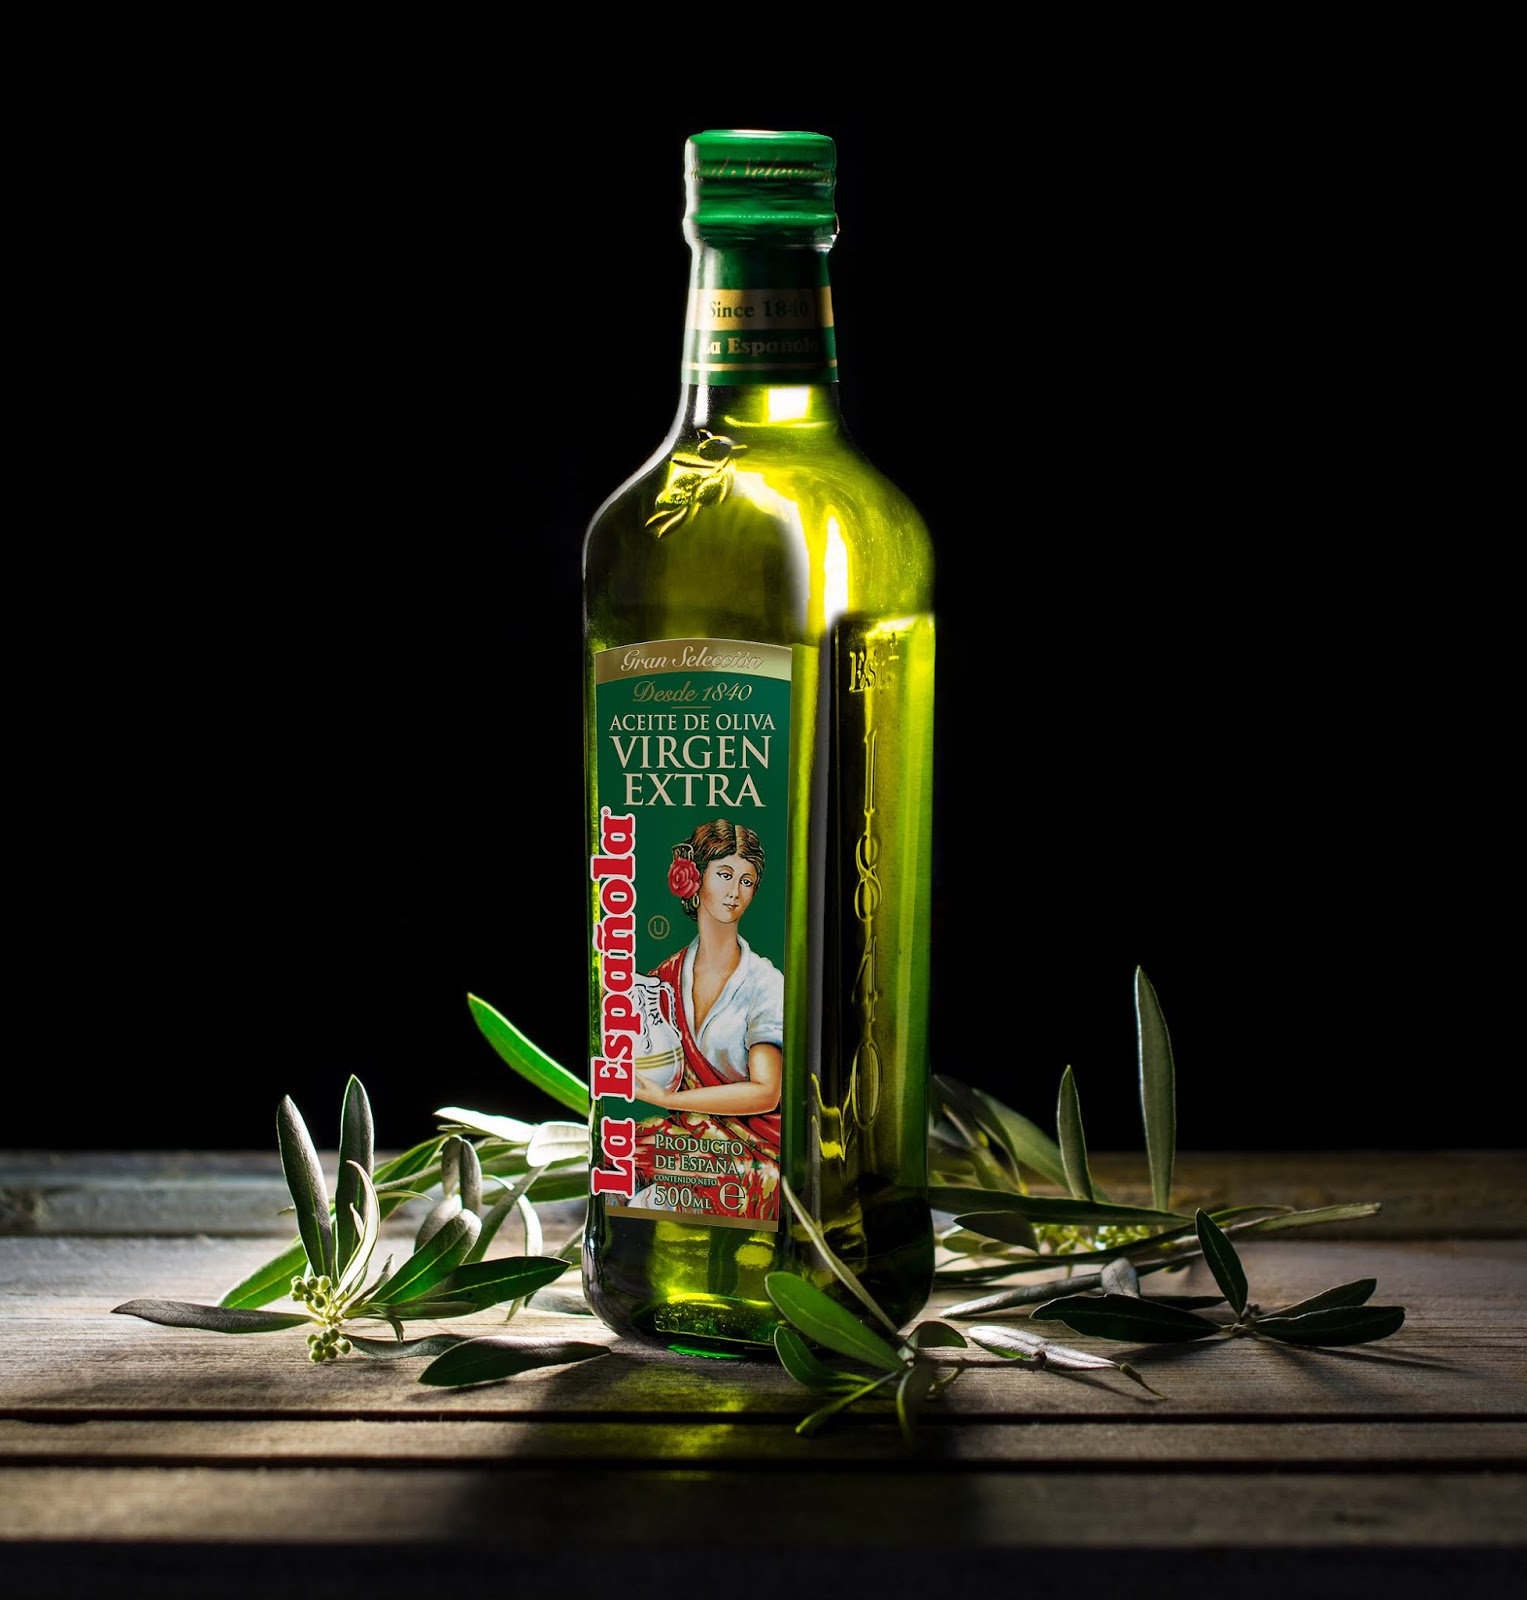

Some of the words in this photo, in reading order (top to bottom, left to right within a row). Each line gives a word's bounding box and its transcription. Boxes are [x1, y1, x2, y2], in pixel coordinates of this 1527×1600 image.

[708, 301, 754, 318] Since
[763, 300, 809, 318] 1840
[621, 649, 669, 672] Gran
[672, 645, 765, 670] Selección
[633, 680, 699, 703] Desde
[702, 682, 753, 702] 1840
[609, 714, 678, 731] ACEITE
[684, 713, 710, 731] DE
[715, 713, 776, 731] OLIVA
[609, 735, 772, 770] VIRGEN
[623, 773, 767, 808] EXTRA
[591, 813, 643, 1101] Española
[654, 1133, 744, 1156] PRODUCTO
[592, 1116, 636, 1199] La
[654, 1154, 676, 1170] DE
[679, 1153, 740, 1176] ESPAÑA
[654, 1173, 696, 1184] CONTENIDO
[697, 1175, 718, 1187] NETO
